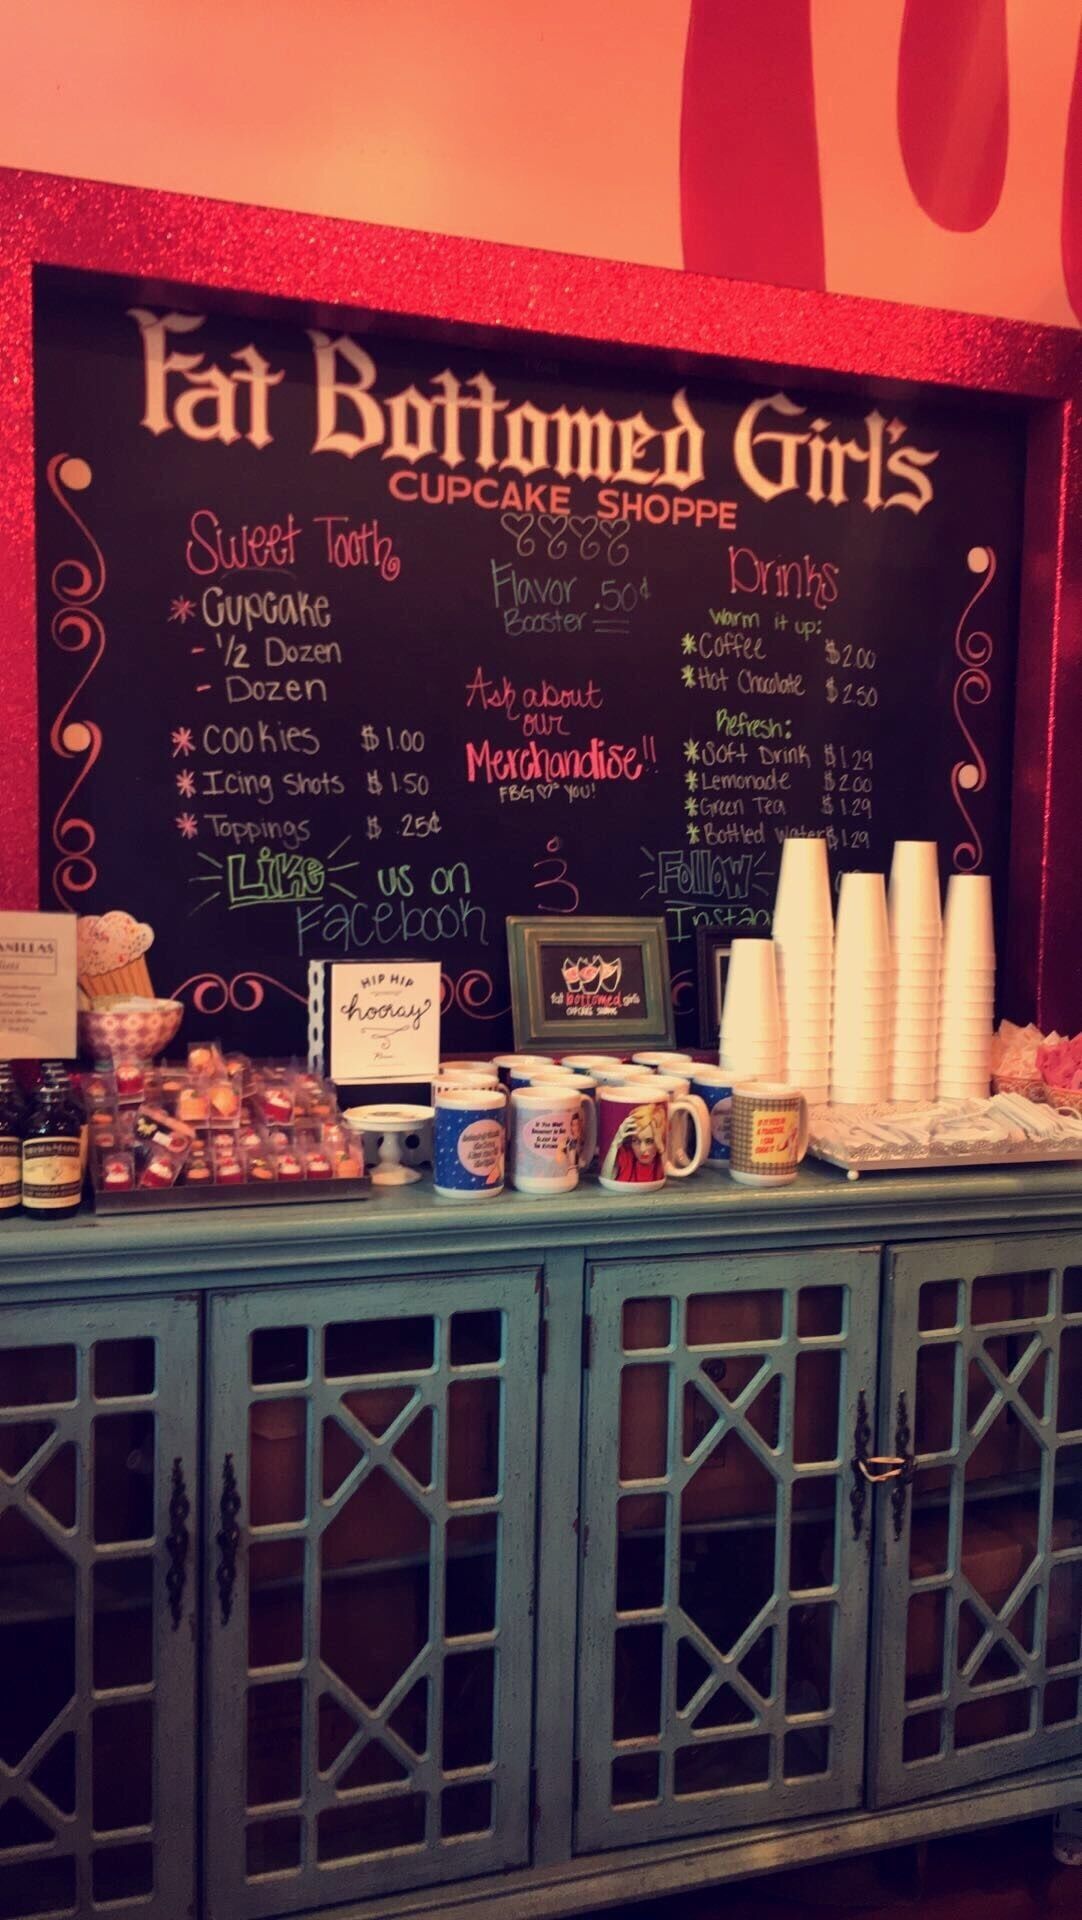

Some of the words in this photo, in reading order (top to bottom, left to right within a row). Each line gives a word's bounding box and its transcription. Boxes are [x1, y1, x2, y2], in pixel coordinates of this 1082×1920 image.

[126, 307, 285, 449] Fat
[306, 329, 706, 490] Bottomed
[733, 392, 941, 514] Girl's
[388, 471, 571, 515] CUPCAKE
[597, 488, 738, 529] SHOPPE
[186, 510, 302, 575] Sweet
[313, 516, 400, 582] Tooth
[490, 558, 578, 608] Flavor
[728, 545, 840, 610] Drinks
[202, 586, 331, 632] Cupcake
[503, 606, 588, 637] Booster
[774, 611, 789, 631] it
[794, 620, 822, 642] up:
[265, 636, 342, 667] Dozen
[700, 632, 767, 660] Coffee
[225, 675, 327, 703] Dozen
[465, 666, 519, 720] Ask
[523, 680, 604, 709] about
[699, 667, 729, 691] Hot
[737, 669, 806, 696] Chocolate
[522, 711, 571, 737] our
[716, 708, 793, 740] Refresh:
[702, 741, 748, 767] Soft
[759, 744, 811, 769] Drink
[202, 769, 274, 804] Icing
[499, 783, 535, 804] FBG
[563, 782, 597, 804] YOU!
[702, 768, 791, 791] Lemonade
[700, 798, 744, 818] Green
[752, 796, 787, 816] Tea
[204, 813, 311, 849] Toppings
[703, 822, 766, 846] Bottled
[226, 846, 325, 903] Like
[377, 864, 414, 896] us
[431, 862, 471, 894] on
[658, 849, 753, 899] Follow
[297, 897, 488, 957] Facebook
[361, 973, 385, 989] HIP
[391, 974, 414, 988] HIP
[341, 993, 432, 1030] hooray
[566, 990, 622, 1008] bottomed
